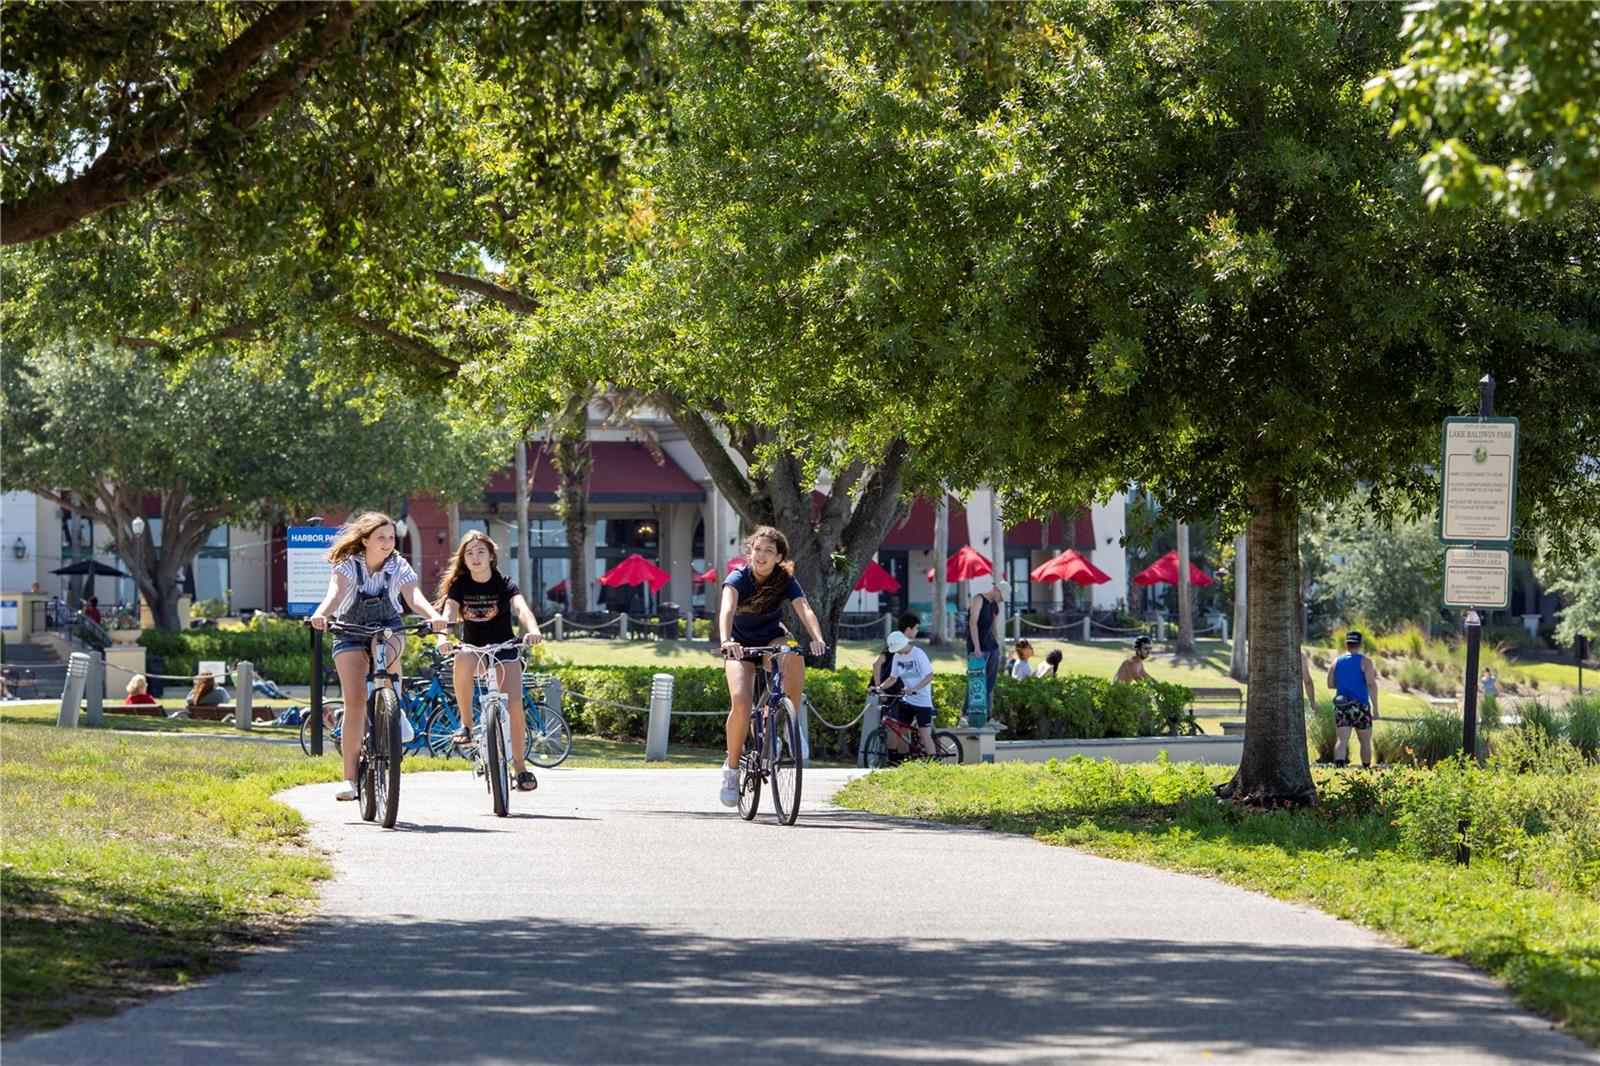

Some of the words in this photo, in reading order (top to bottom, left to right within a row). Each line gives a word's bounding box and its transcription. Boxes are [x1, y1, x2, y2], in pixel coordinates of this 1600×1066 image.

[1449, 430, 1466, 438] LAKE
[1467, 430, 1495, 438] BALDWIN
[1496, 430, 1512, 438] PARK
[291, 534, 324, 542] HARBOR
